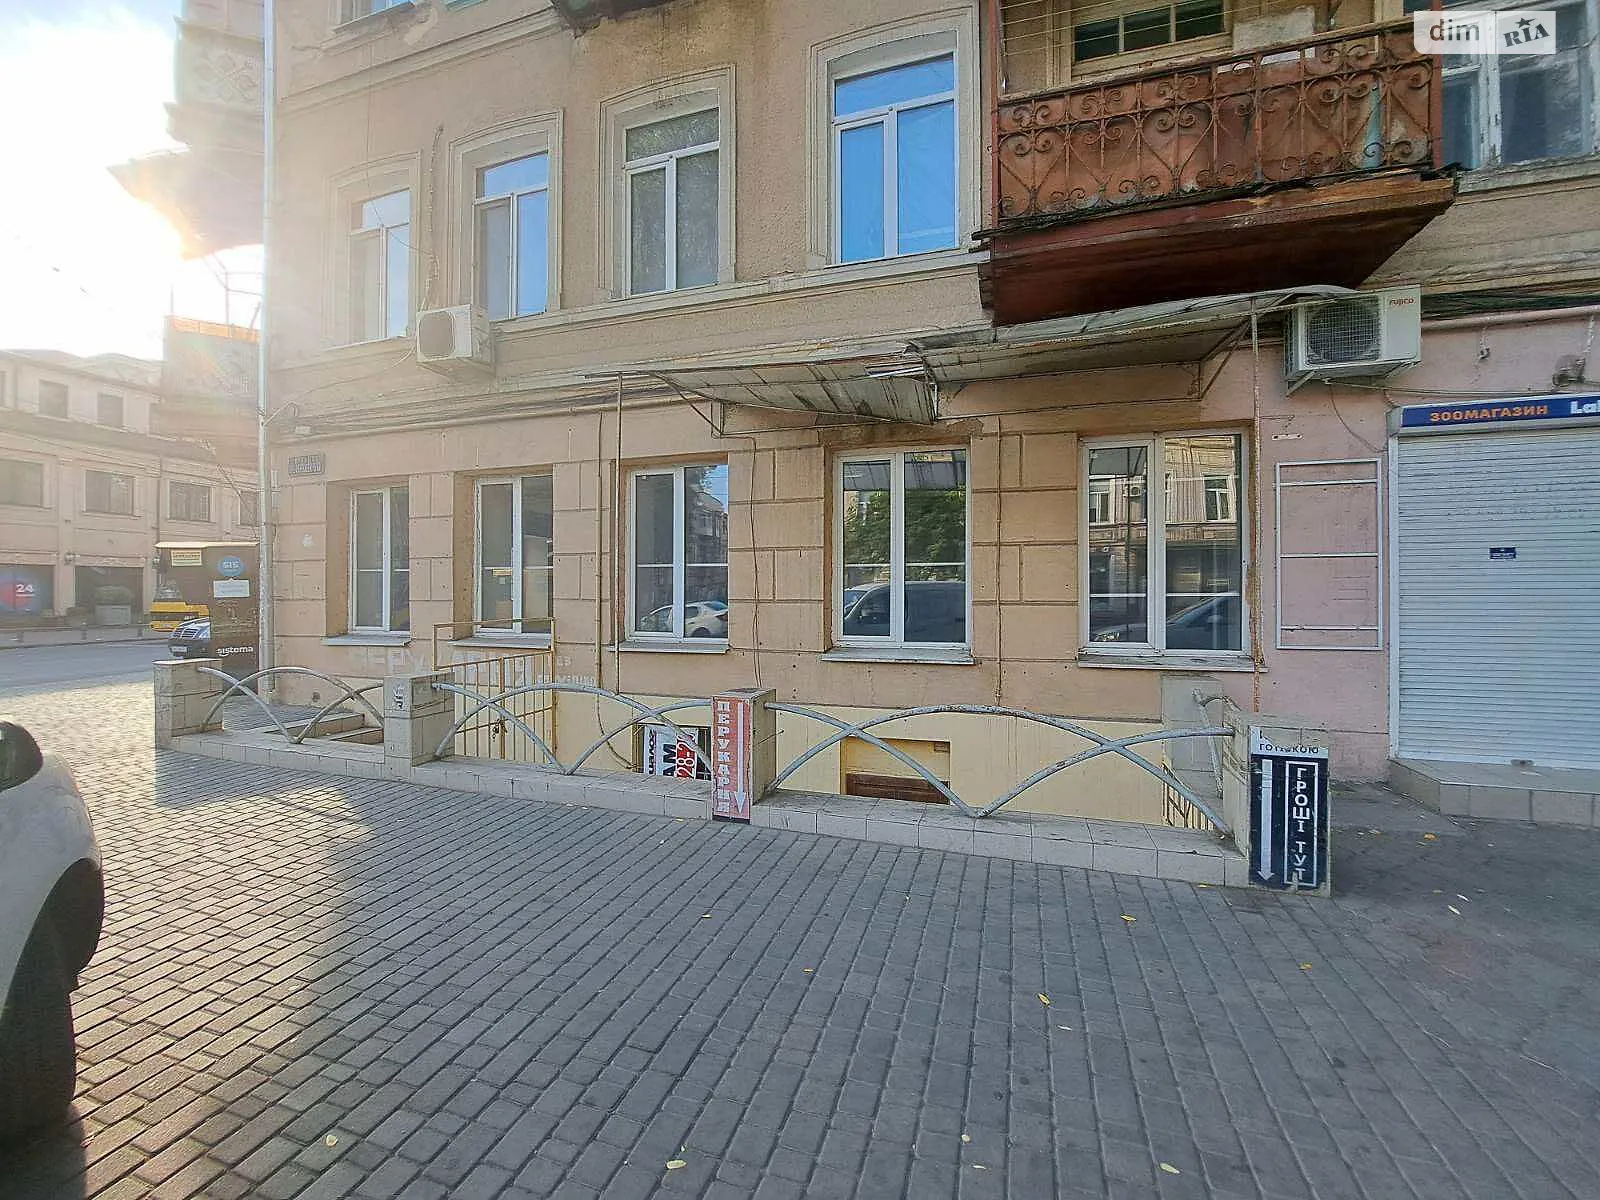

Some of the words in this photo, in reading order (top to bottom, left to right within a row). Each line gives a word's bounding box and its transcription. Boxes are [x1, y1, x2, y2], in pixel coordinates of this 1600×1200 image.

[1429, 405, 1548, 422] ЗООМАГАЗИН
[717, 701, 731, 813] ПЕРУКАРНЯ
[1292, 767, 1311, 833] ГРОШІ
[1293, 840, 1307, 881] ТУТ
